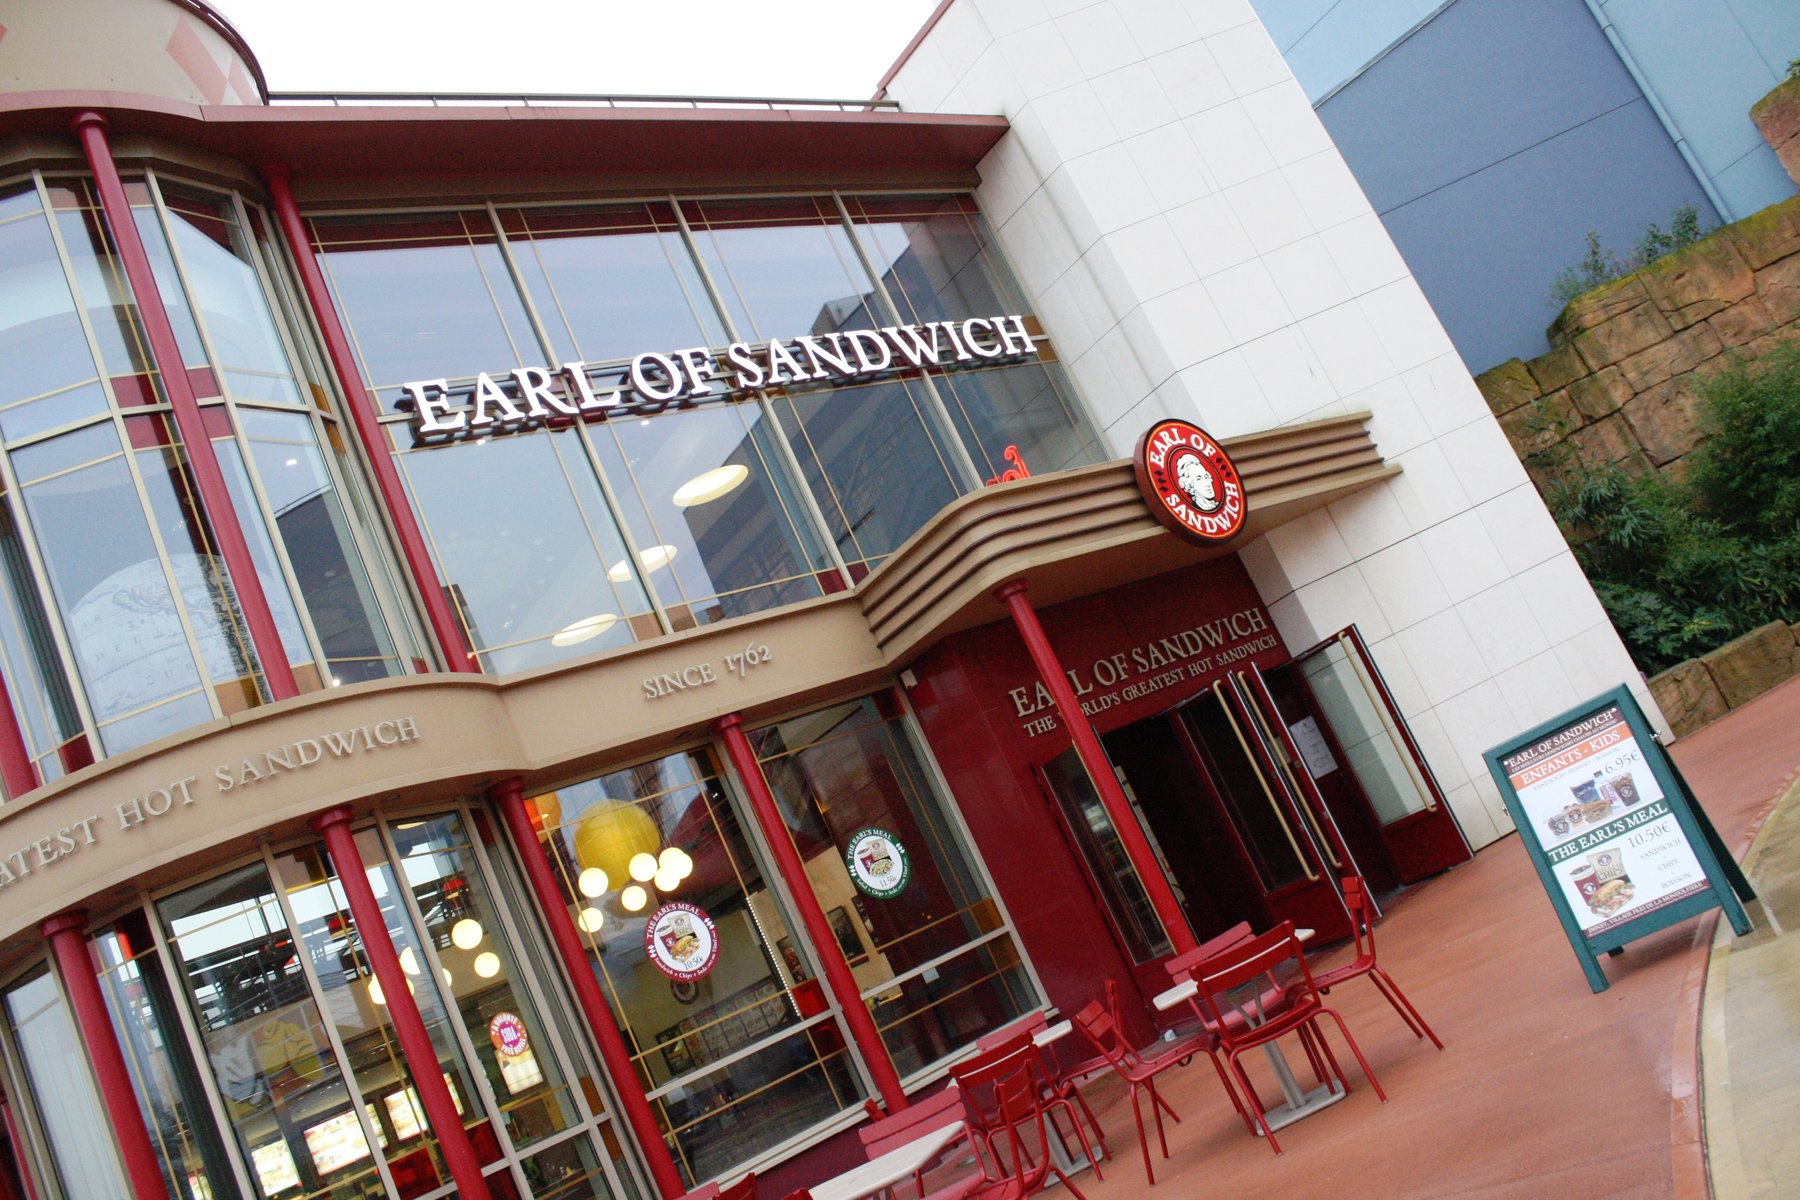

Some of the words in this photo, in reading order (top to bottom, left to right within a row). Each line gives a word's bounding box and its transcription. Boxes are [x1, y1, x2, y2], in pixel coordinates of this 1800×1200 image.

[403, 361, 621, 435] EARL
[630, 347, 716, 401] OF
[728, 315, 1038, 392] SANDWICH
[1150, 428, 1186, 468] EARL
[1190, 434, 1217, 457] OF
[1165, 480, 1240, 534] SANDWICH
[643, 663, 717, 699] SINCE
[725, 641, 773, 677] 1762
[1008, 668, 1093, 718] EAL
[1093, 653, 1127, 687] OF
[1132, 607, 1269, 675] SANDWICH
[1023, 715, 1057, 738] THE
[1122, 668, 1186, 702] GREATEST
[1189, 657, 1215, 678] HOT
[1216, 634, 1278, 666] SANDWICH
[1508, 748, 1538, 768] EARL
[1538, 740, 1555, 754] OF
[1554, 710, 1614, 744] SANDWICH
[1521, 748, 1582, 785] ENFANTS
[1589, 730, 1621, 752] KIDS
[1605, 750, 1640, 775] 6.95€
[114, 776, 198, 831] HOT
[215, 716, 422, 793] SANDWICH
[852, 829, 873, 843] EARL'S
[873, 829, 892, 840] MEAL
[1549, 841, 1579, 862] THE
[1579, 820, 1626, 848] EARL'S
[1626, 802, 1669, 828] MEAL
[1628, 821, 1673, 849] 10.50€
[646, 921, 656, 939] THE
[653, 904, 676, 920] EARL'S
[678, 903, 699, 915] MEAL
[679, 972, 693, 980] Chips
